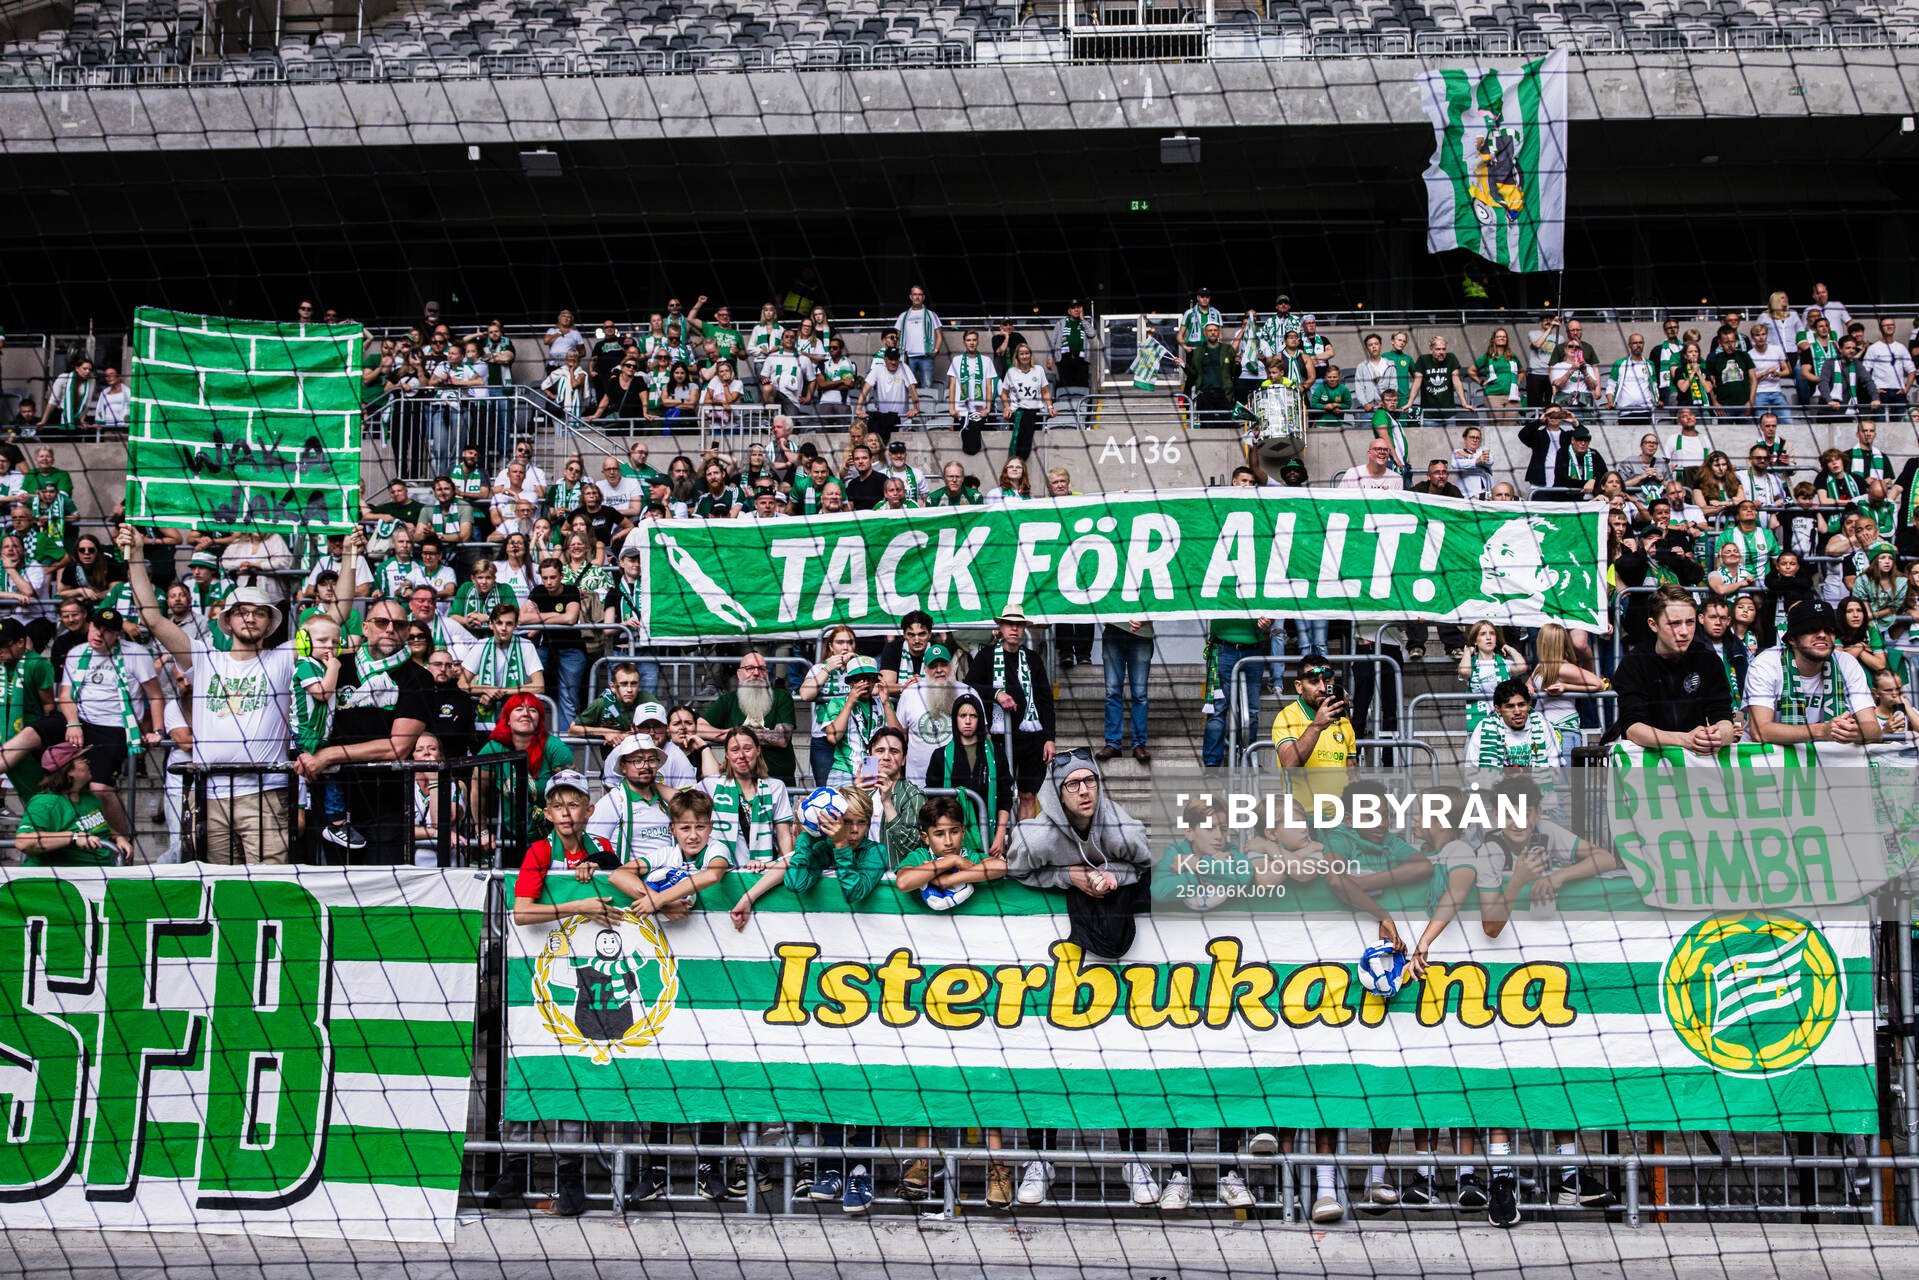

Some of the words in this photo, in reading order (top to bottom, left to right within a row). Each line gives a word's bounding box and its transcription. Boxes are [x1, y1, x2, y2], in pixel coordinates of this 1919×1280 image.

[183, 429, 331, 475] WAKA
[1098, 435, 1182, 465] A136
[208, 486, 329, 526] WAKA
[769, 527, 992, 624] TACK
[1008, 514, 1182, 606] FÖR
[1201, 510, 1446, 603] ALLT!
[1612, 741, 1817, 820] BAJEN
[1613, 826, 1837, 905] SAMBA
